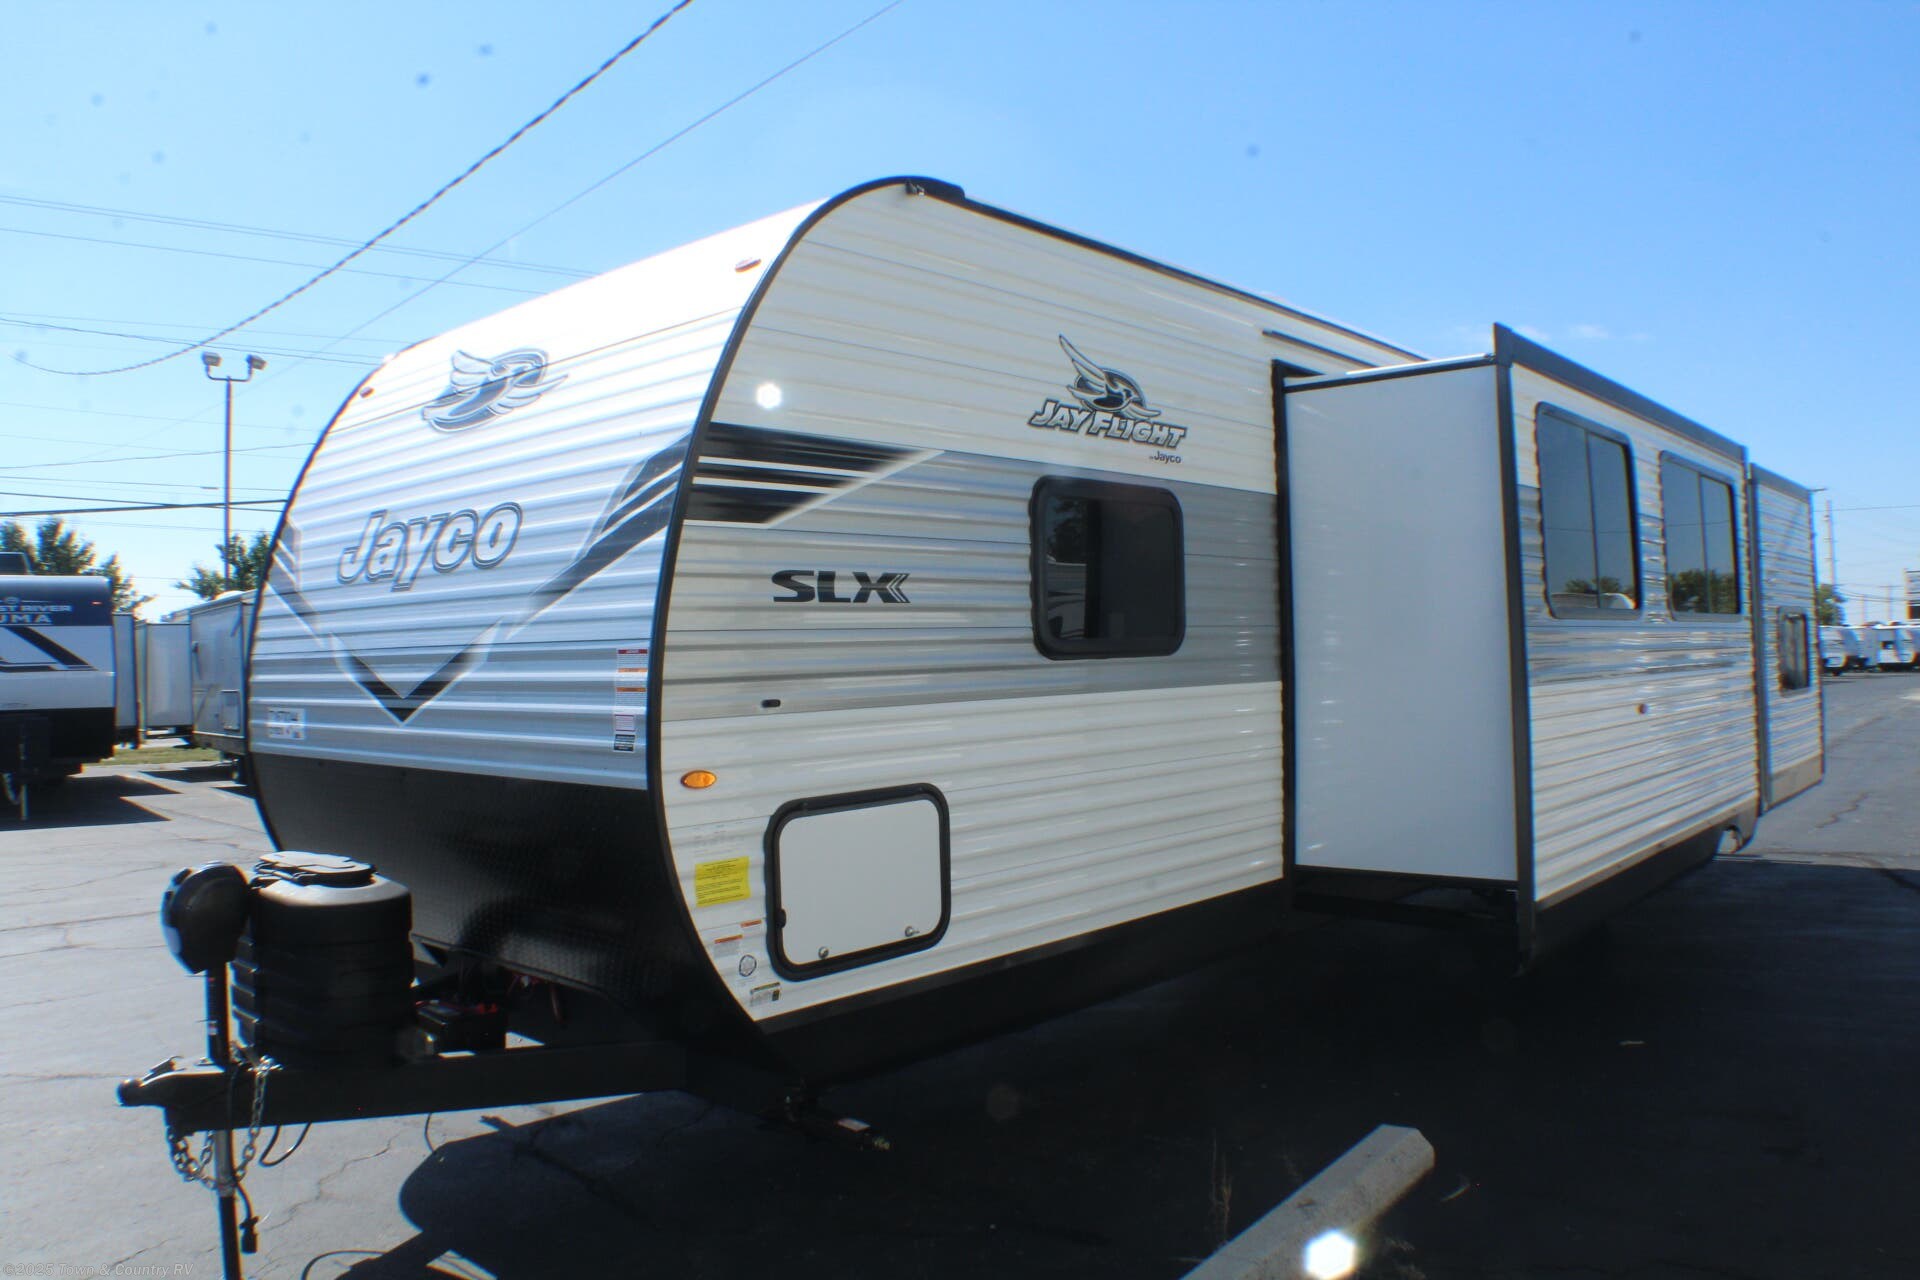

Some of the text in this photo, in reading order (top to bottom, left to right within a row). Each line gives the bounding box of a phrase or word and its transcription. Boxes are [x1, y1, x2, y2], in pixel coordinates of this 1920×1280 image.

[1028, 398, 1188, 449] JAY FLIGHT
[1154, 450, 1182, 464] Jayco
[337, 502, 523, 592] Jayco
[771, 570, 911, 603] SLX
